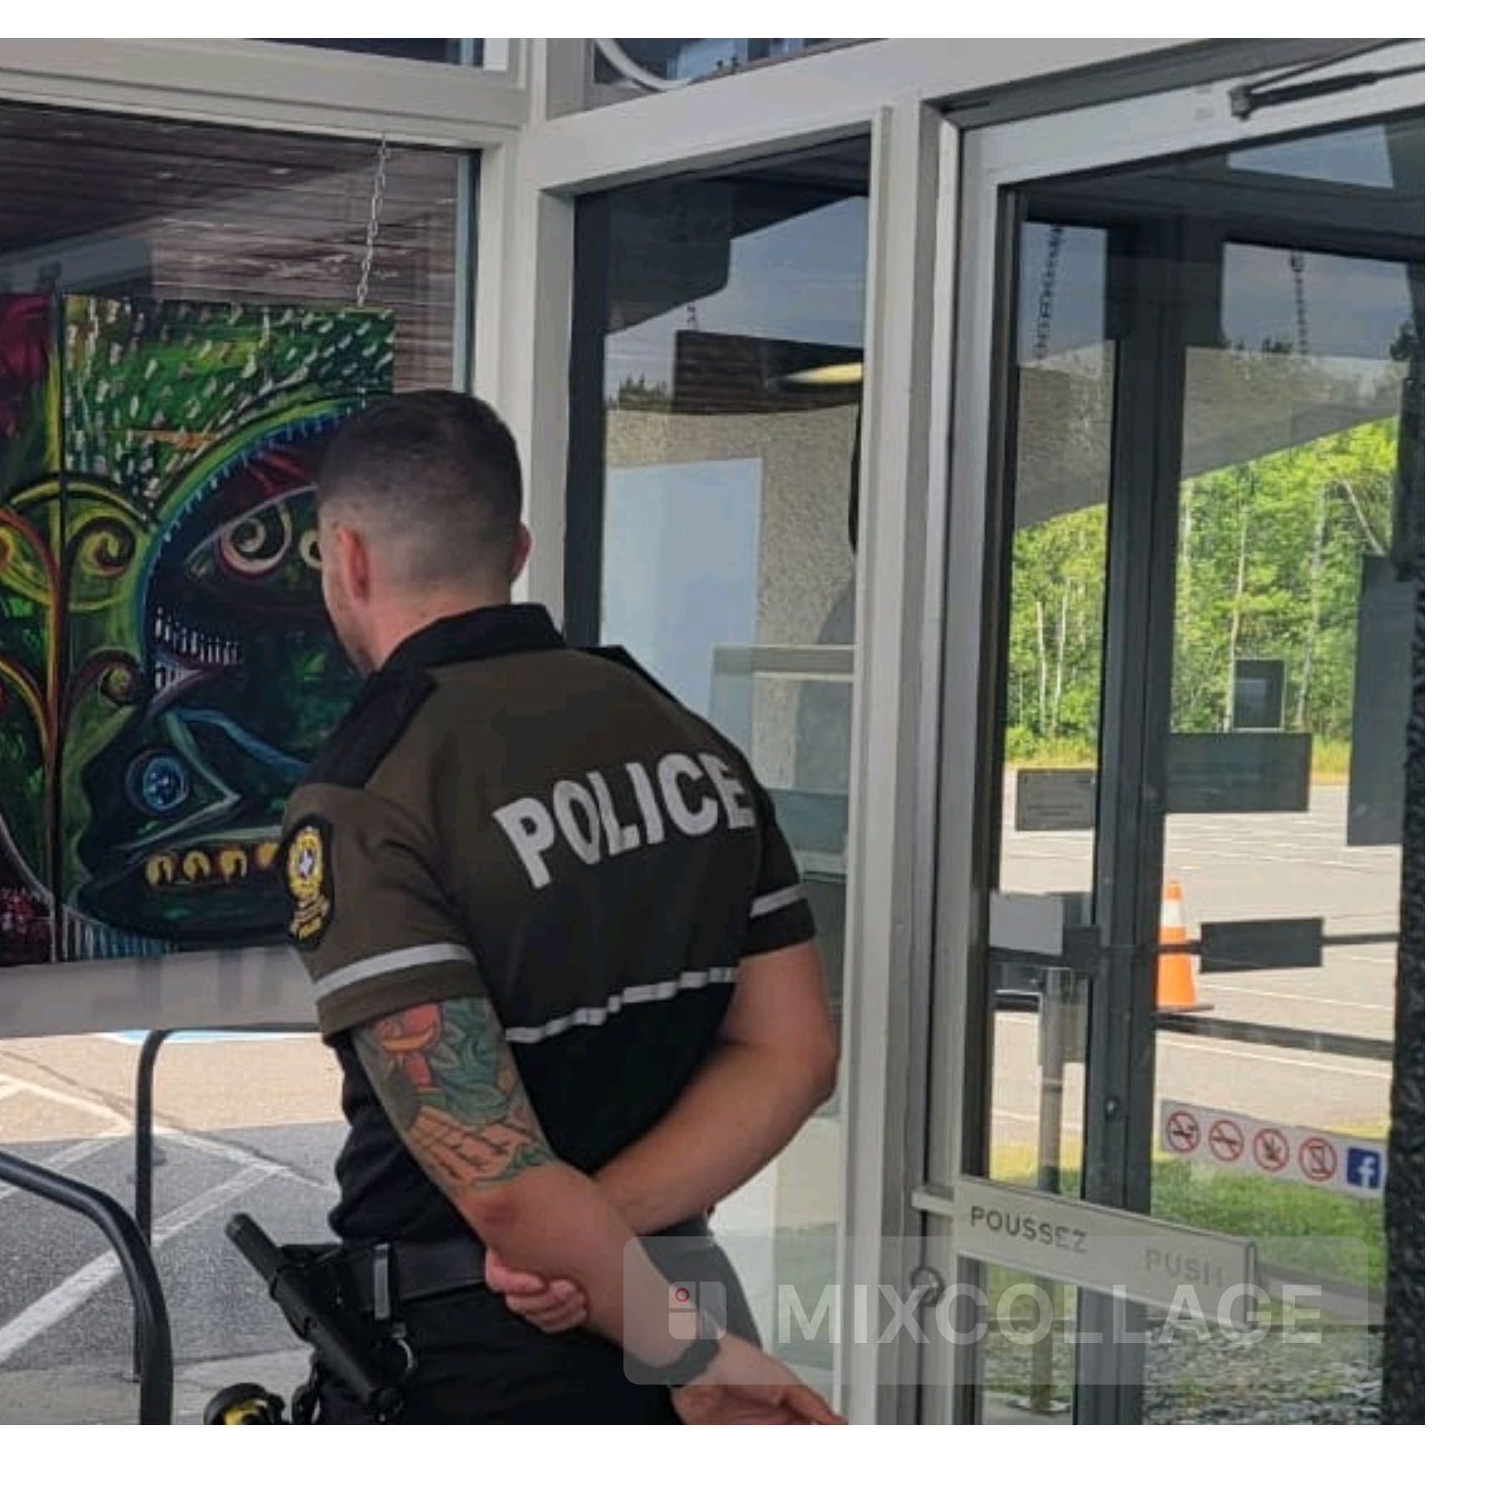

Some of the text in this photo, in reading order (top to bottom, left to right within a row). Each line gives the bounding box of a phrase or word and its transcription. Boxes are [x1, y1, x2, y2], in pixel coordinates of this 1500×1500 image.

[491, 752, 756, 890] POLICE
[970, 1205, 1223, 1288] POUSSEZ PUSH
